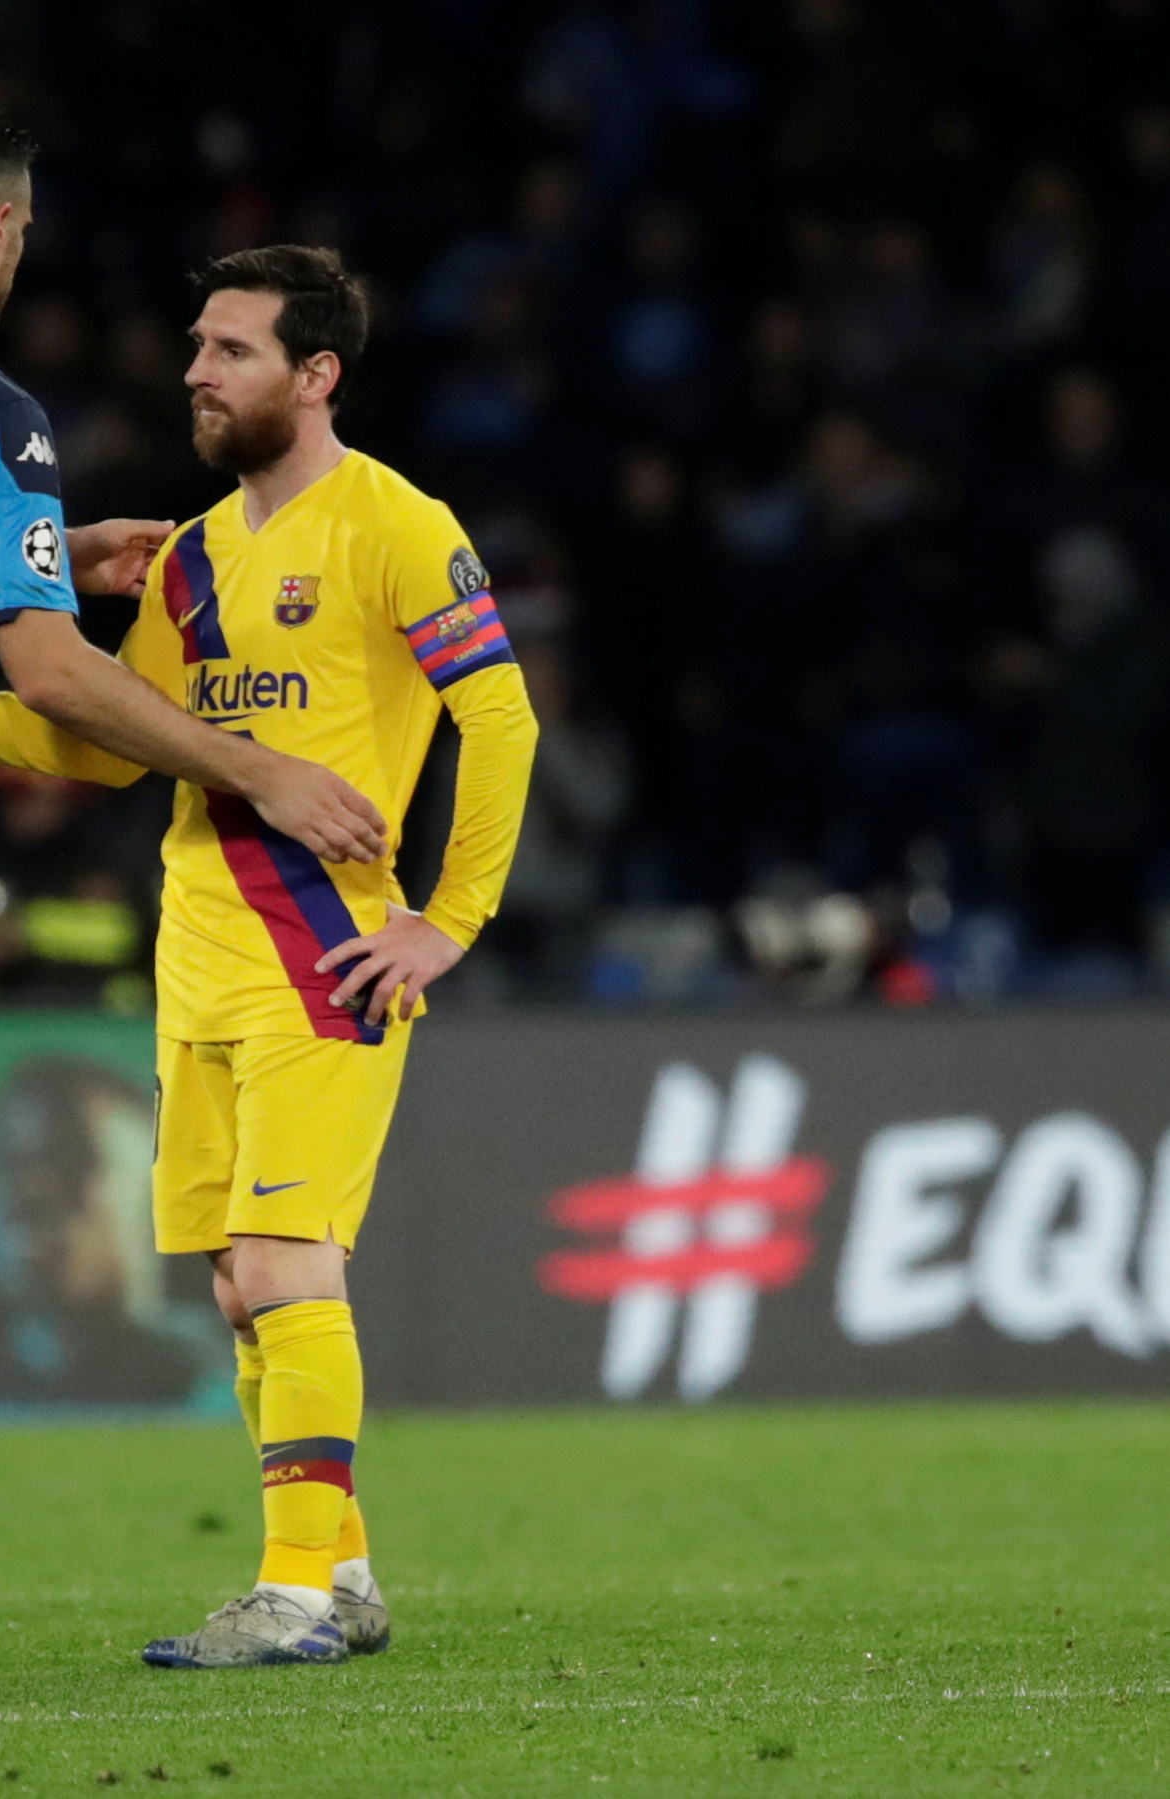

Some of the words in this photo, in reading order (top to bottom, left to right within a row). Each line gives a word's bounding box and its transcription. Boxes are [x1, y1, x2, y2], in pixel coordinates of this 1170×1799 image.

[466, 573, 478, 592] 5
[186, 663, 308, 712] kuten
[533, 1050, 1170, 1405] #EQ
